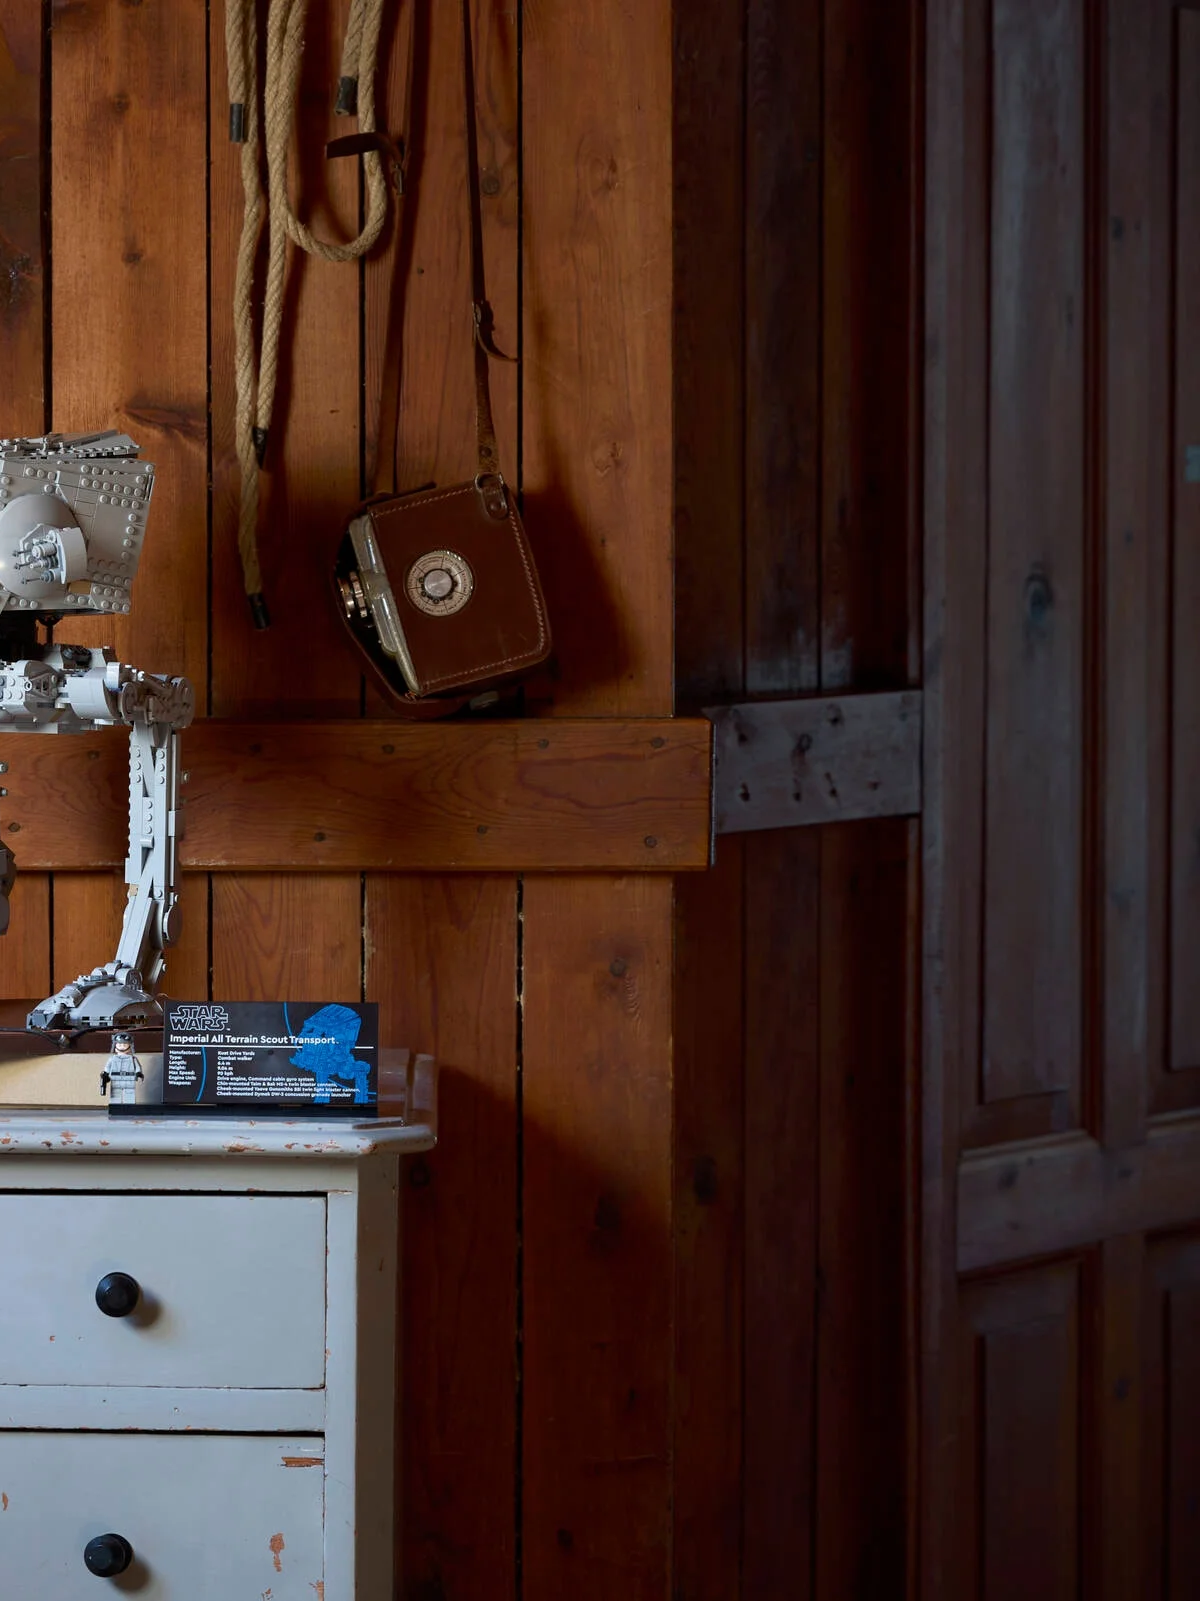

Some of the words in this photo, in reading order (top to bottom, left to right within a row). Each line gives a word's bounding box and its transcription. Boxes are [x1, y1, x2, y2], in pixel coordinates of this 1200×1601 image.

[170, 1006, 228, 1018] STAR
[170, 1018, 228, 1030] WARS
[170, 1034, 209, 1044] Imperial
[211, 1034, 223, 1042] All
[225, 1035, 258, 1043] Terrain
[289, 1036, 336, 1045] Transport
